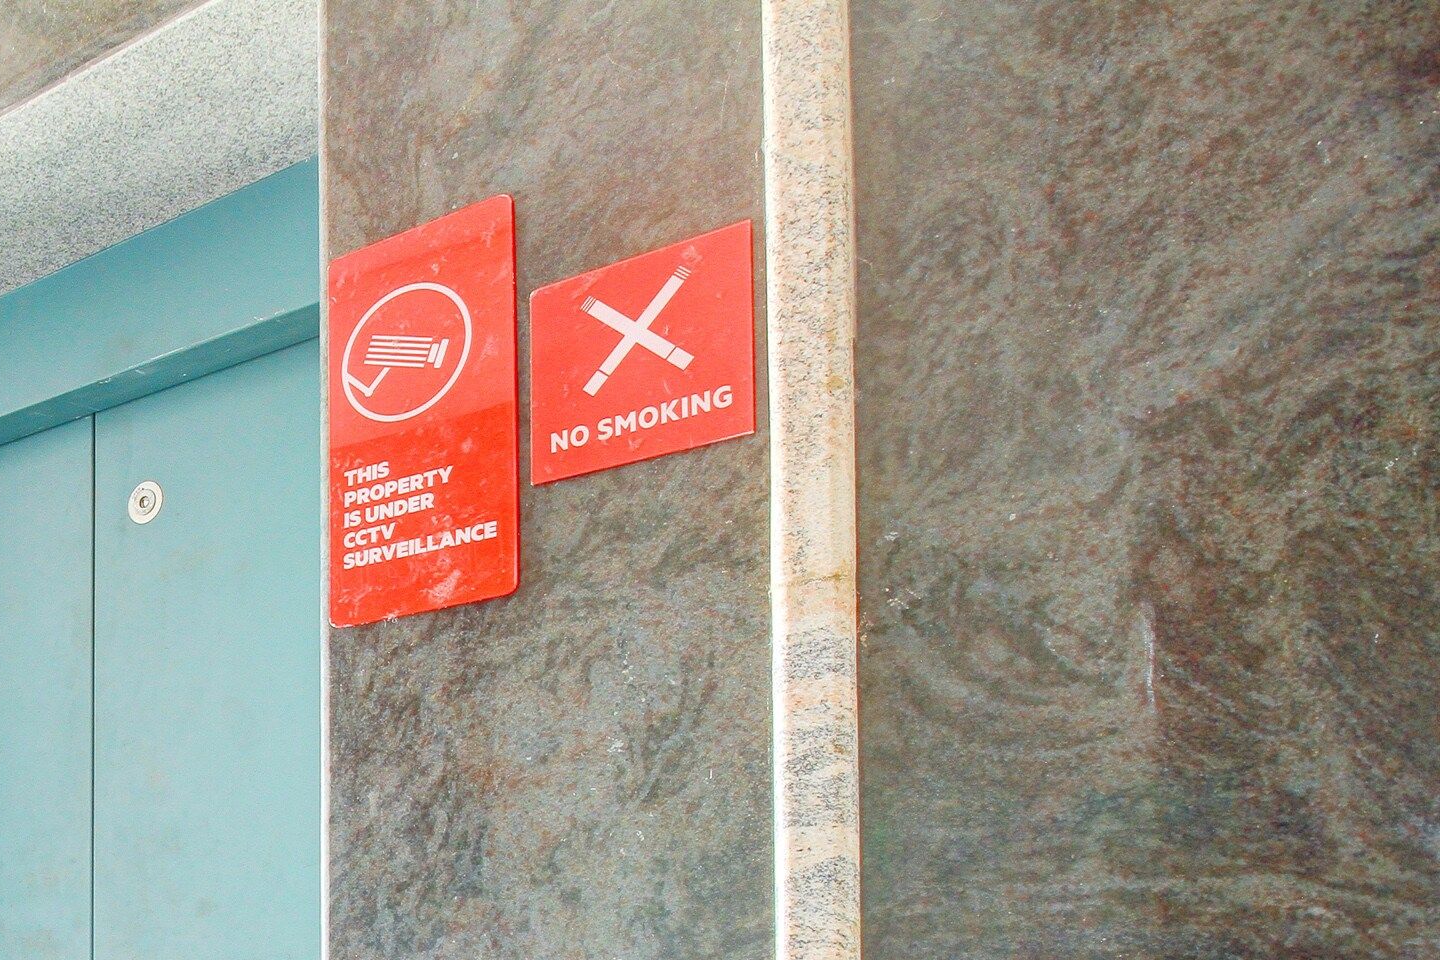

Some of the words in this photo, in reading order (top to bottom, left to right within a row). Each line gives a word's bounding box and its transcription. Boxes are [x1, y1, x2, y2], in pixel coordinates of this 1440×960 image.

[549, 424, 590, 454] NO
[597, 385, 734, 441] SMOKING
[344, 461, 390, 488] THIS
[344, 466, 453, 508] PROPERTY
[344, 511, 362, 530] IS
[365, 493, 435, 525] UNDER
[343, 520, 498, 570] SURVEILLANCE
[344, 522, 395, 550] CCTV
